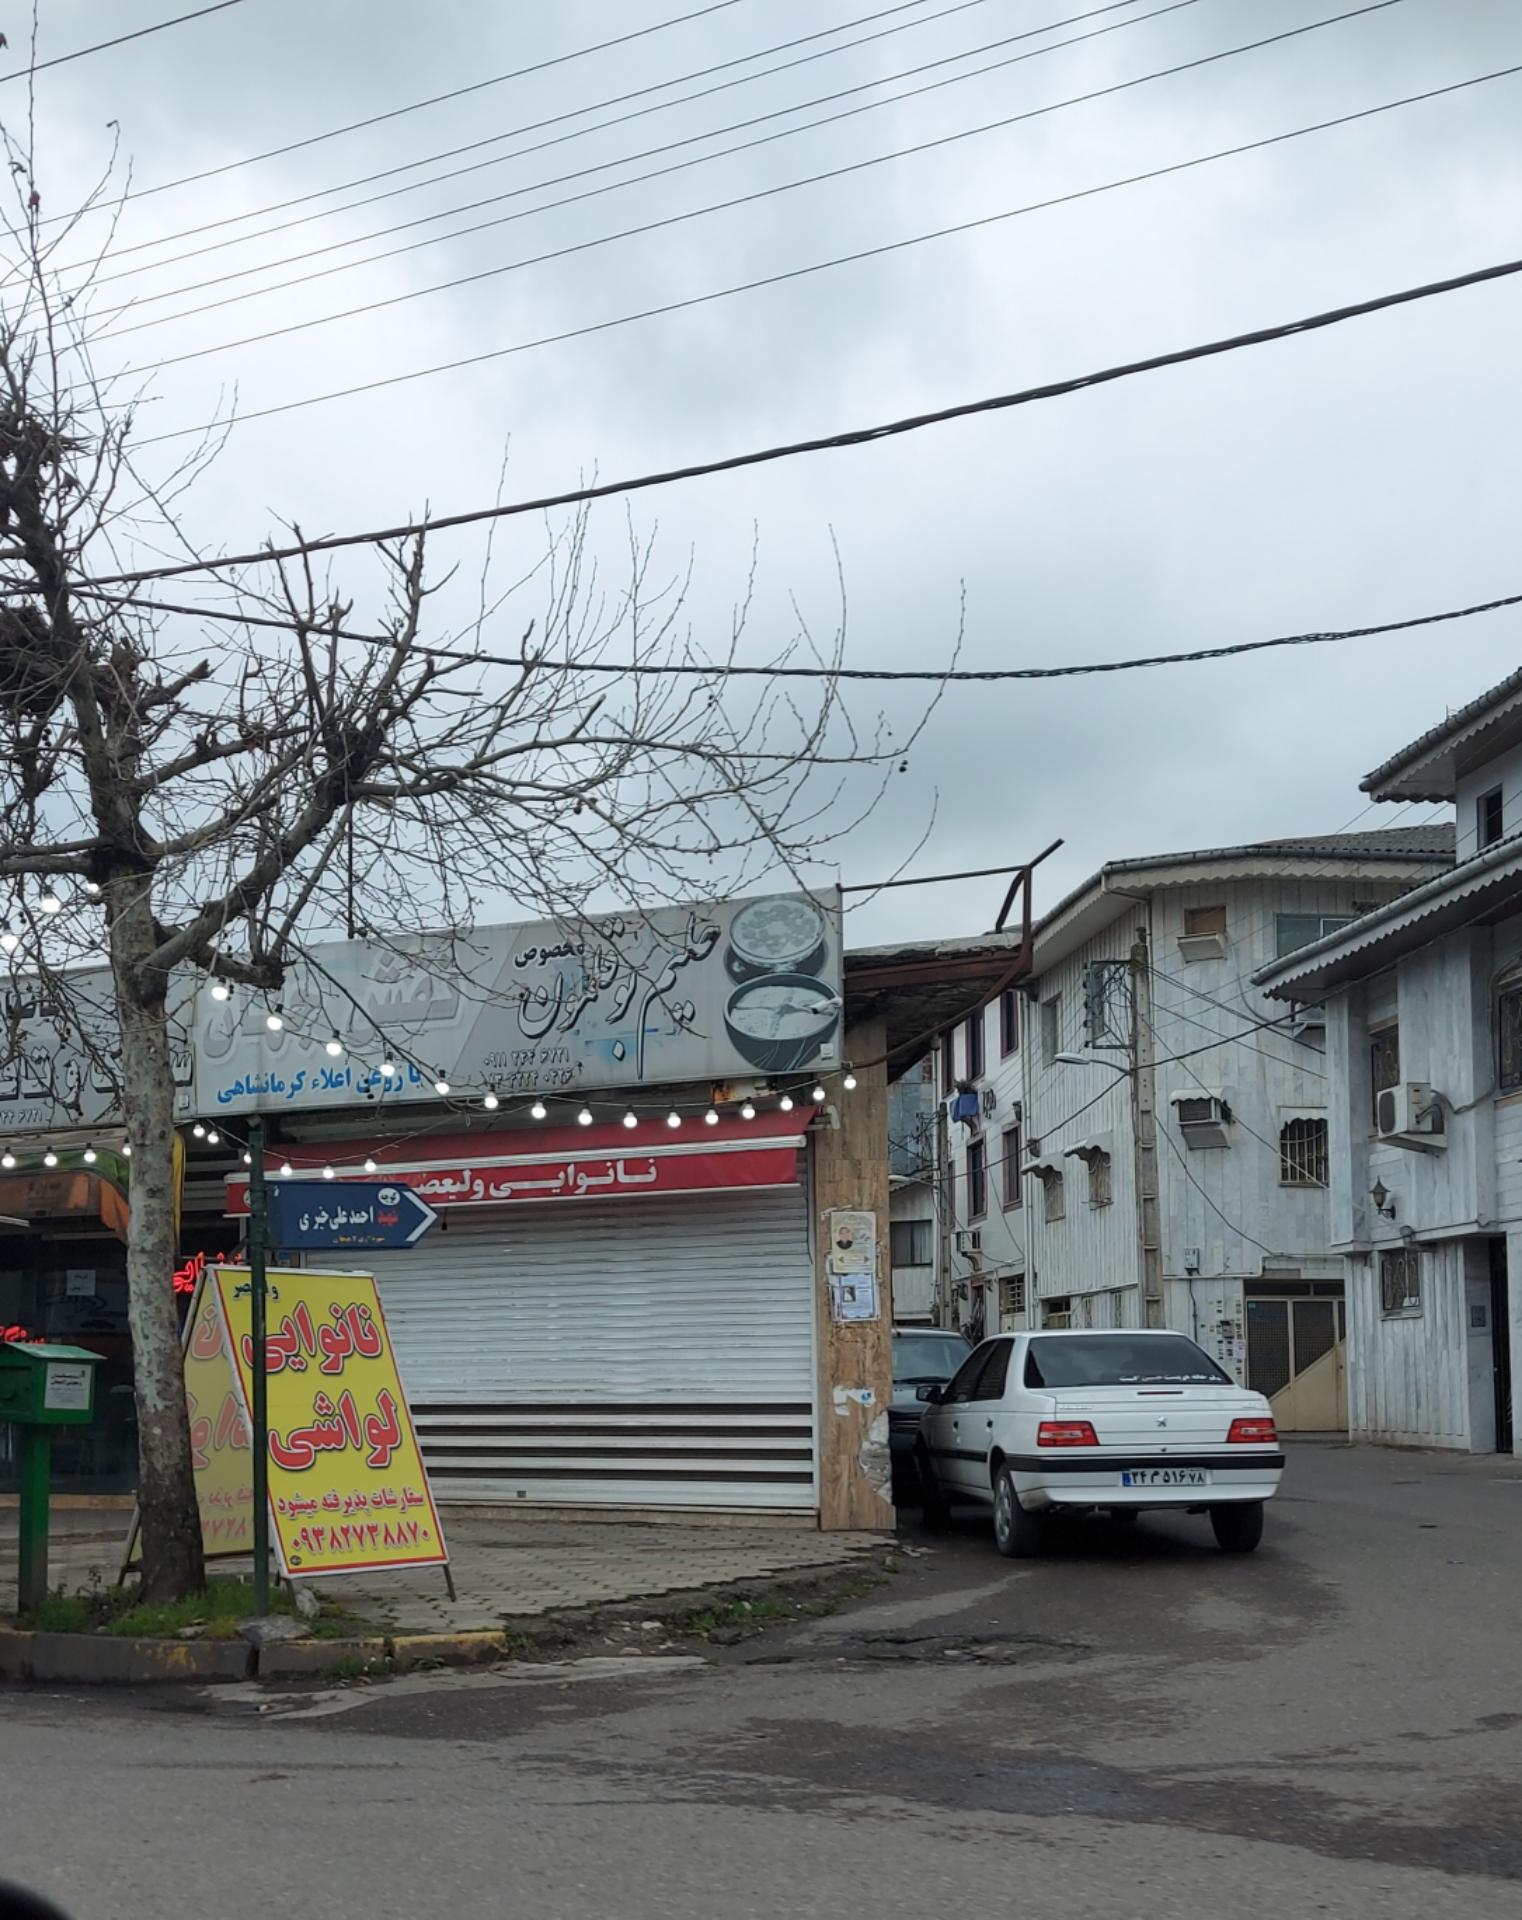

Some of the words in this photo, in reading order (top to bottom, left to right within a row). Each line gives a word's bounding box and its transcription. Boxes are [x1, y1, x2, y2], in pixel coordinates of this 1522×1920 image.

[515, 942, 585, 968] مخصوص
[217, 1070, 306, 1103] کرمانشاهی
[312, 1067, 352, 1090] اعلاء
[409, 1169, 485, 1200] ولیعص
[489, 1158, 657, 1199] نانوایی
[329, 1205, 348, 1231] علی
[349, 1205, 374, 1225] احمد
[241, 1301, 383, 1375] نانوایی
[268, 1388, 402, 1471] لواشی
[370, 1487, 424, 1513] سفارشات
[292, 1520, 430, 1553] ۰۹۳۸۲۷۳۸۸۷۰
